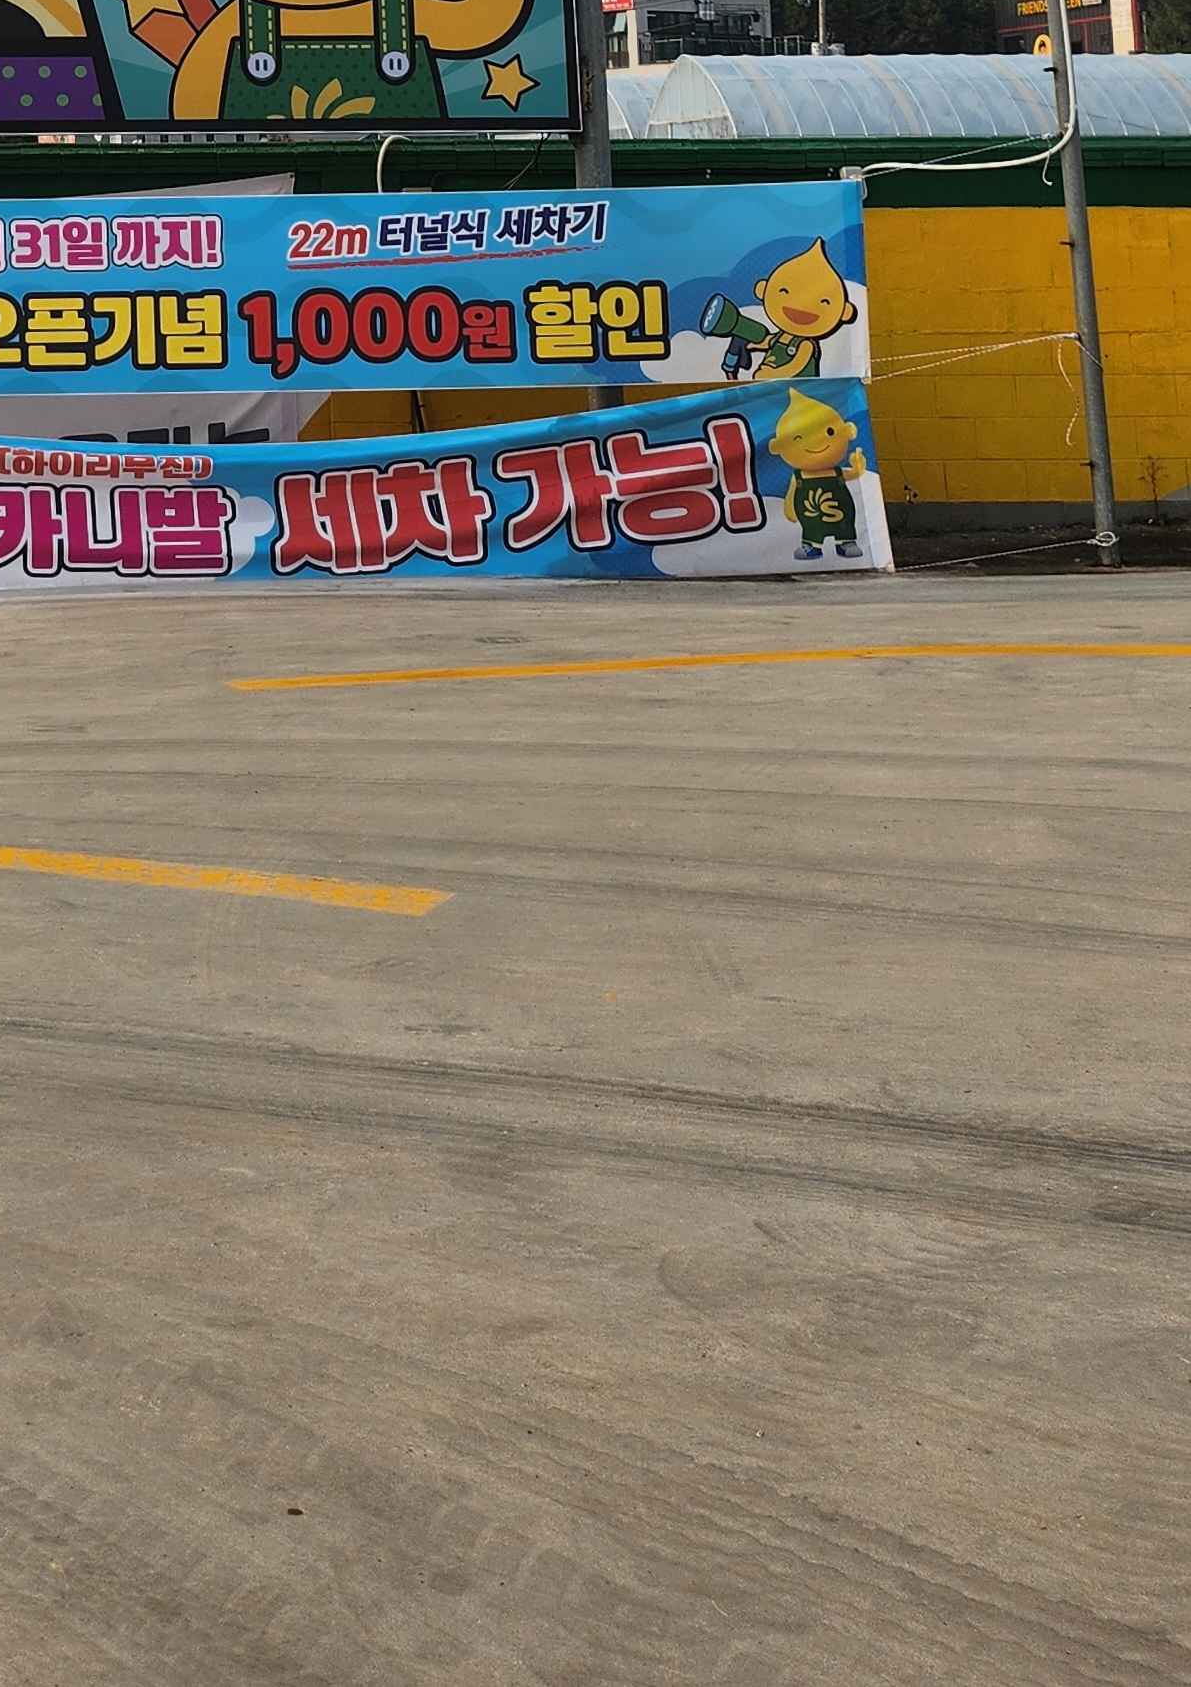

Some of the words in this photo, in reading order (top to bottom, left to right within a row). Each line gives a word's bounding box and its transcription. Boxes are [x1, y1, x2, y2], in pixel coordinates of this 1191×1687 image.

[11, 220, 106, 266] 31일
[115, 218, 218, 265] 까지!
[288, 224, 368, 258] 22m
[379, 213, 484, 252] 터널식
[498, 204, 606, 244] 세차기
[242, 292, 511, 375] 1,000원
[529, 285, 666, 359] 할인
[279, 458, 492, 571] 세차
[499, 420, 762, 543] 가능!
